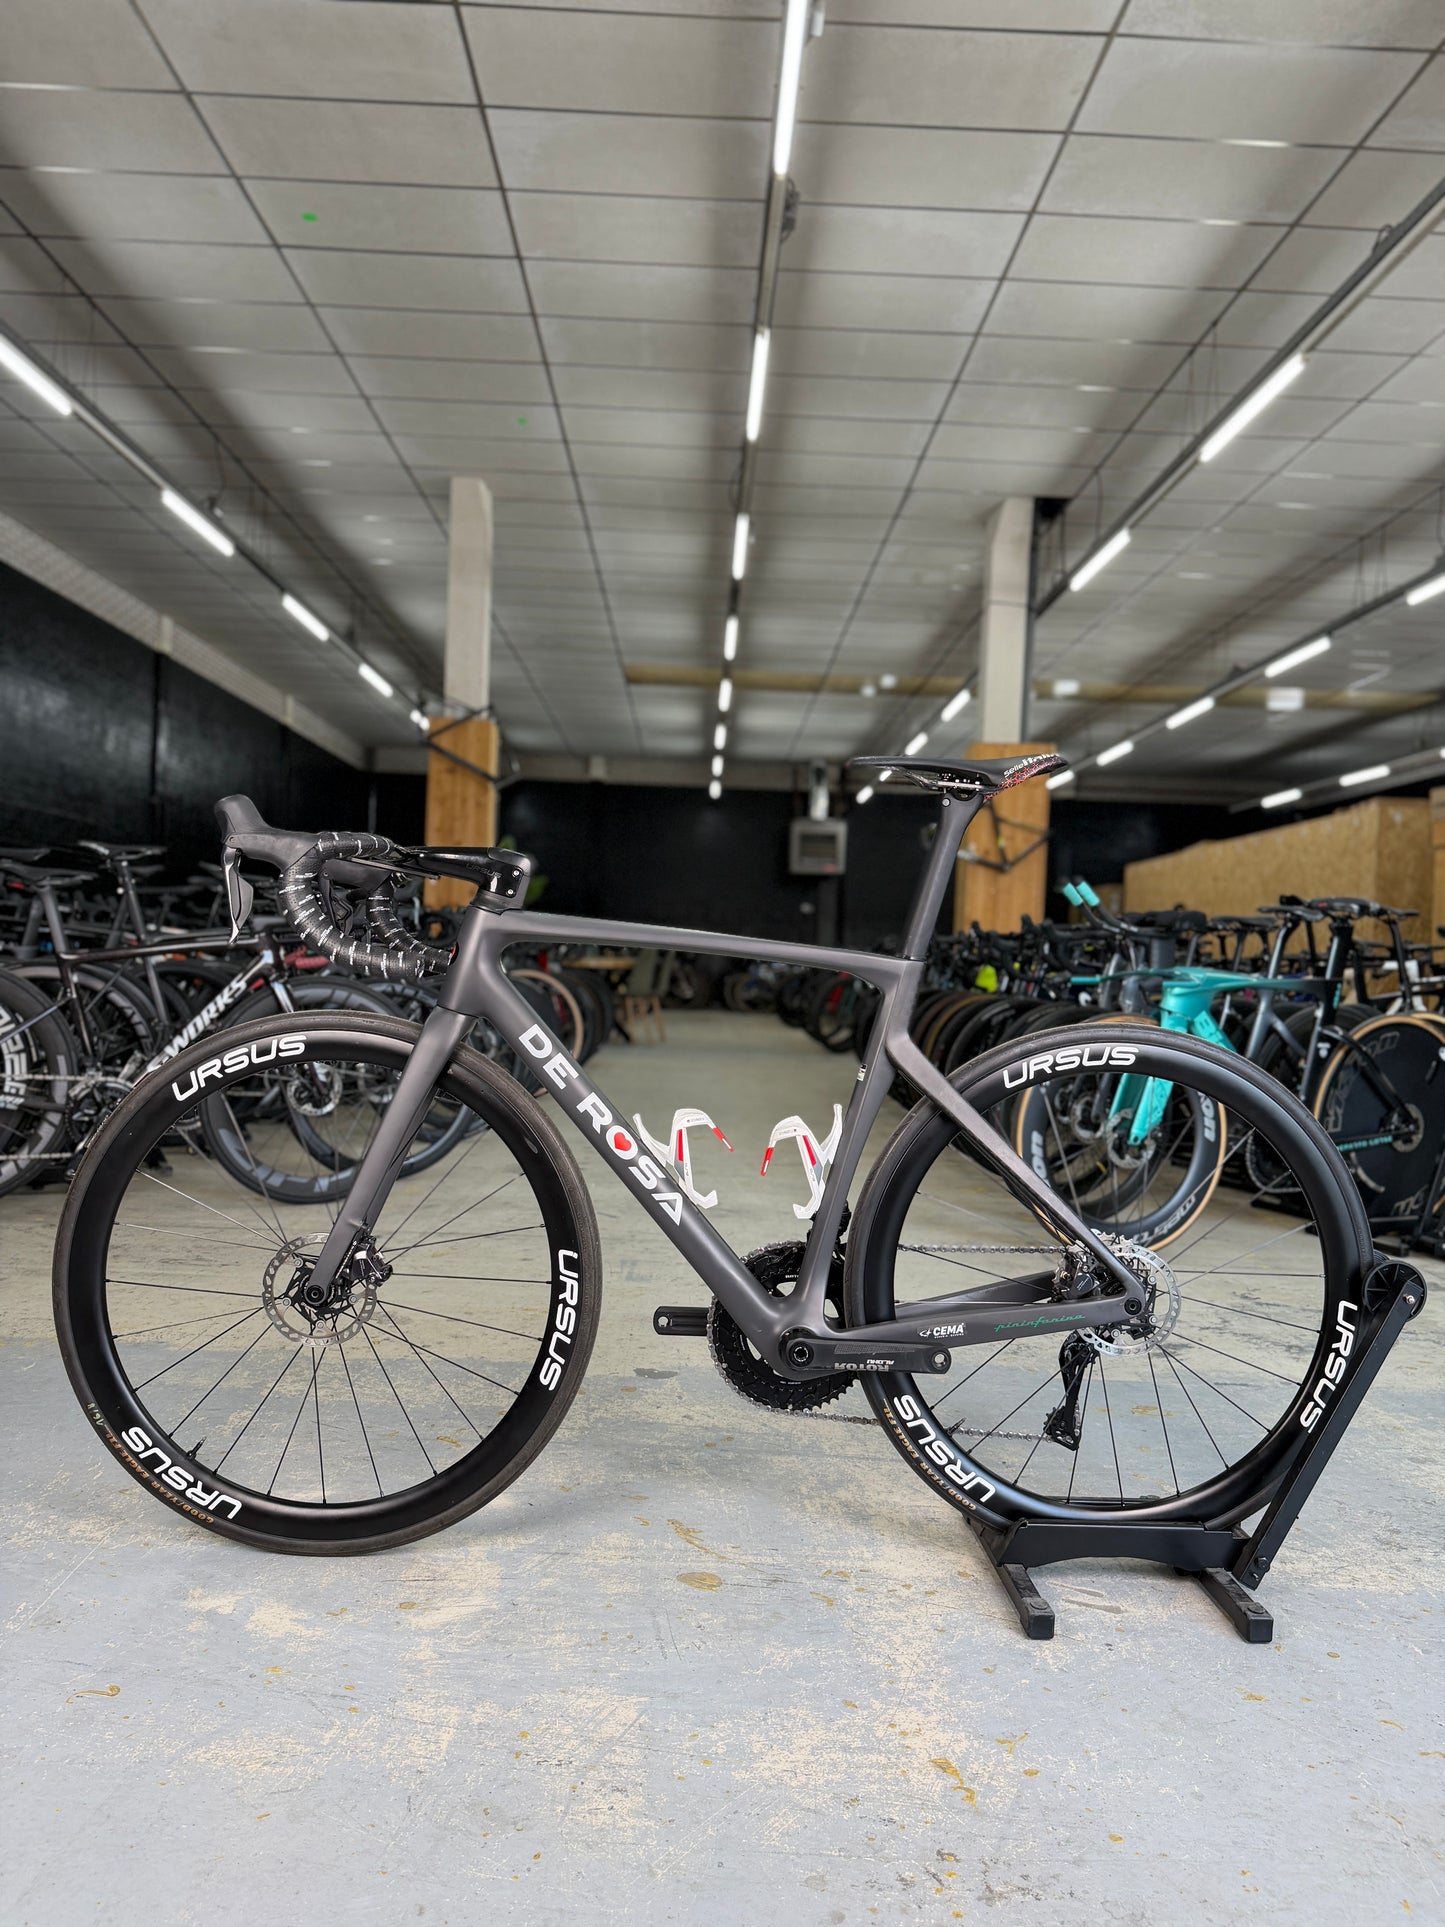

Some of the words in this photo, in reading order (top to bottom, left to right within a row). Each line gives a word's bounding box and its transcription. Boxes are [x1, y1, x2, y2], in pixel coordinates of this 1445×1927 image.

[171, 1034, 308, 1102] URSUS
[1002, 1046, 1139, 1089] URSUS
[518, 1023, 580, 1090] DE
[576, 1091, 684, 1227] ROSA
[539, 1249, 579, 1391] URSUS
[932, 1324, 964, 1336] CEMA
[993, 1314, 1086, 1333] pininfarina
[834, 1362, 889, 1371] ROTOR
[1299, 1300, 1359, 1434] URSUS
[120, 1449, 150, 1480] EAGLE
[893, 1426, 919, 1459] EAGLE
[893, 1394, 996, 1503] URSUS
[121, 1426, 243, 1520] URSUS
